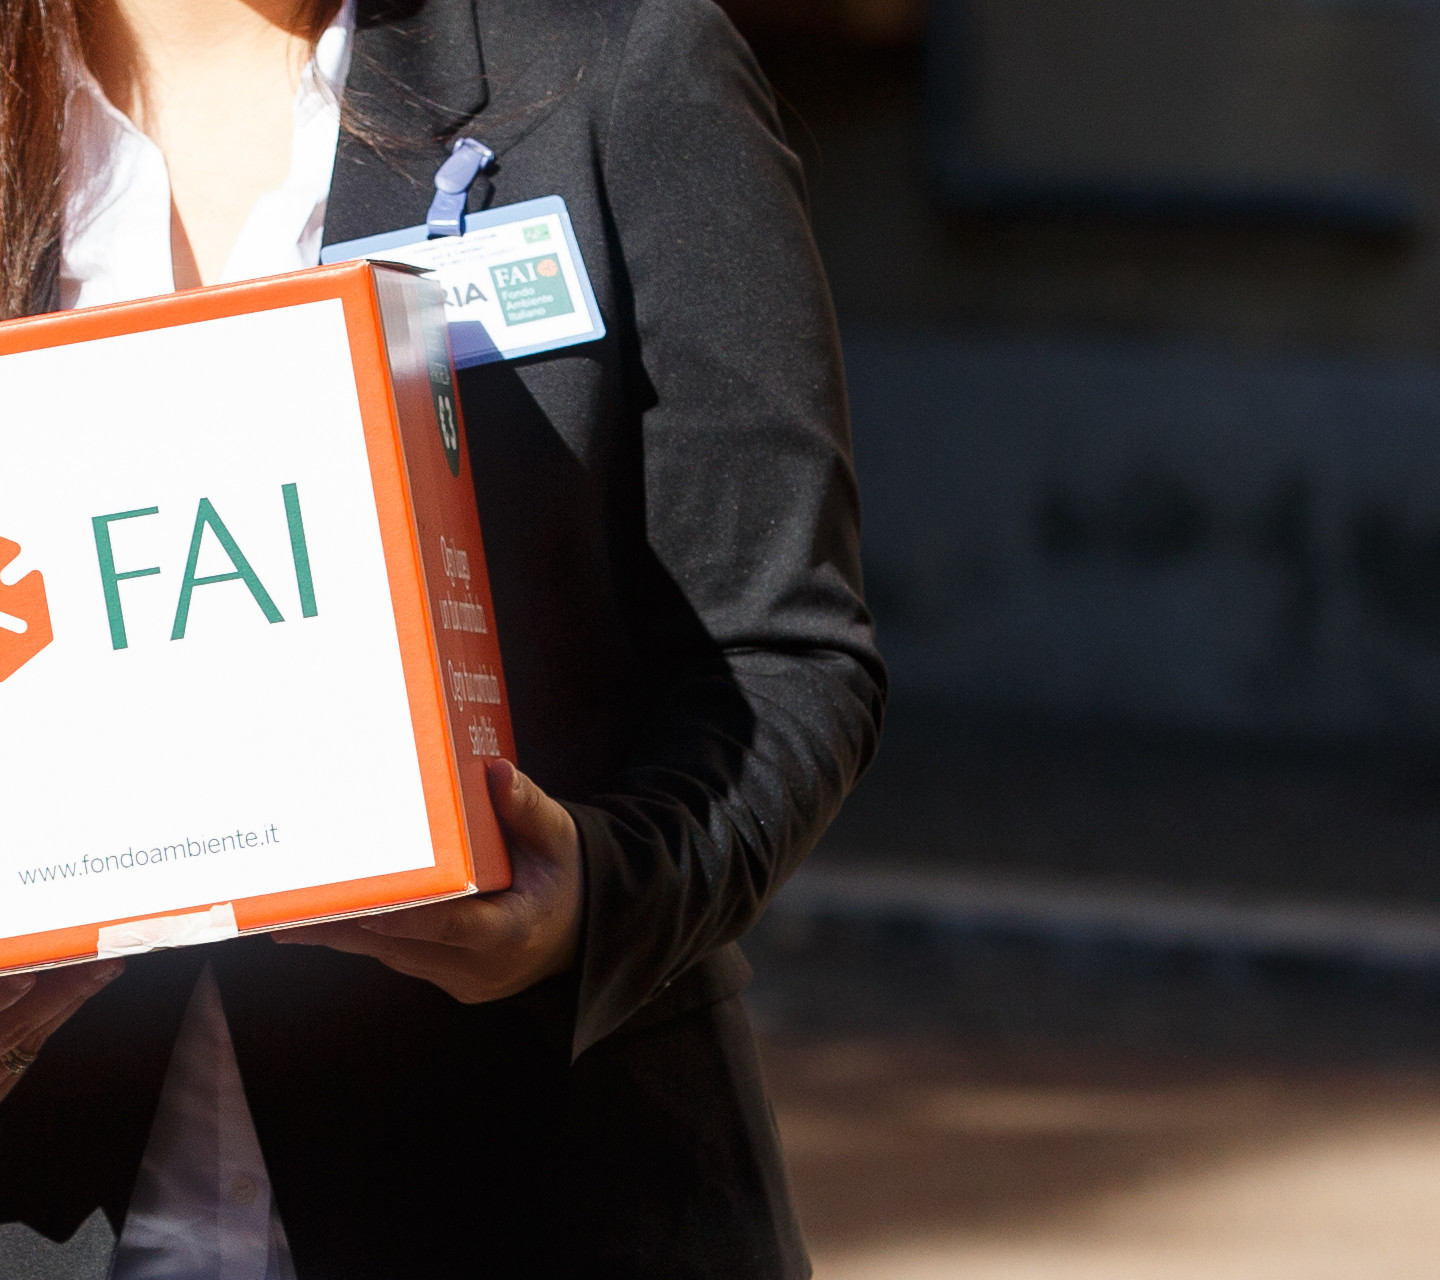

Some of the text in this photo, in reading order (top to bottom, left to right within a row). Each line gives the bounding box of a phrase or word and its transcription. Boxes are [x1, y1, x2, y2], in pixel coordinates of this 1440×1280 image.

[494, 261, 538, 288] FAI
[91, 482, 319, 651] FAI
[18, 823, 280, 886] www.fondoambiente.it
